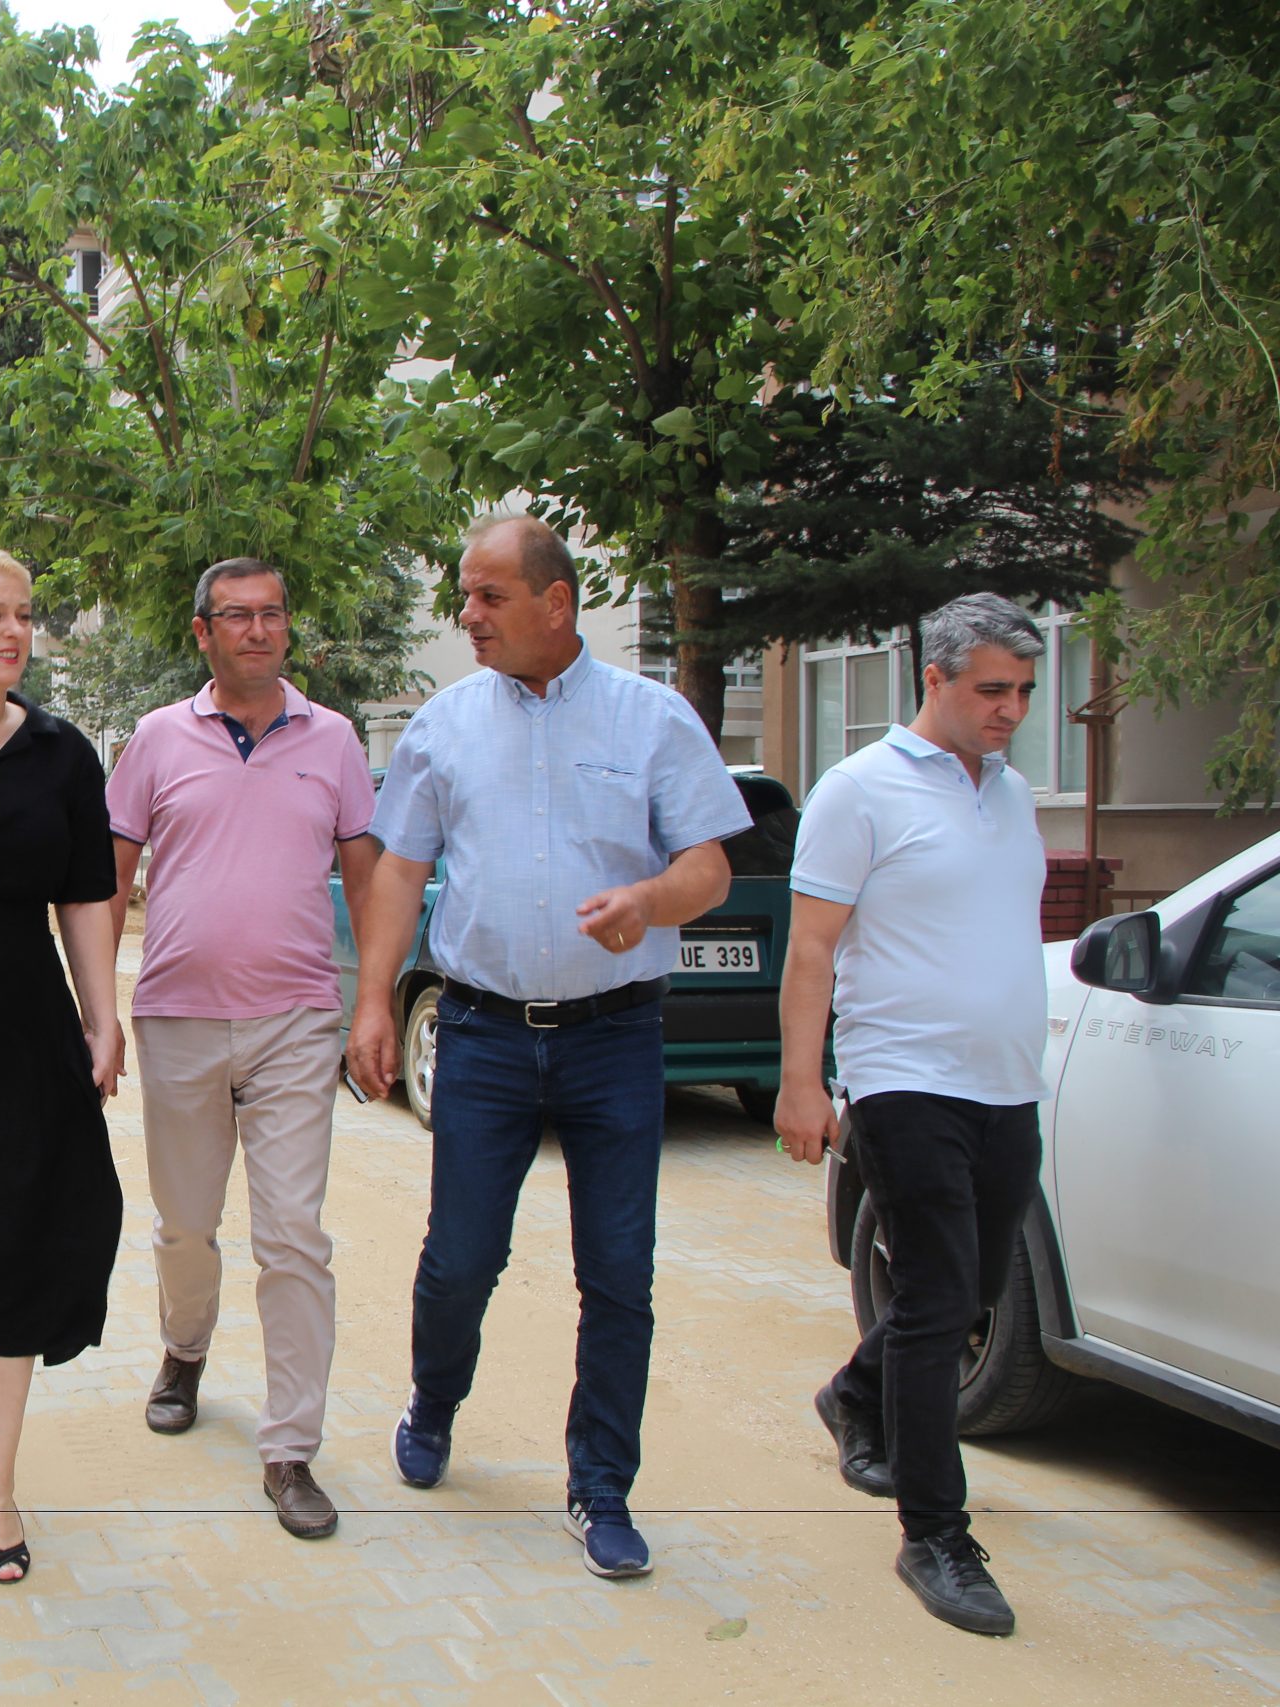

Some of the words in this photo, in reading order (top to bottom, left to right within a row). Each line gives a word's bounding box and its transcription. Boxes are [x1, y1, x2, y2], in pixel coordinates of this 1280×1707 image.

[681, 946, 706, 968] UE
[717, 946, 753, 967] 339
[1085, 1018, 1243, 1059] STEPWAY
